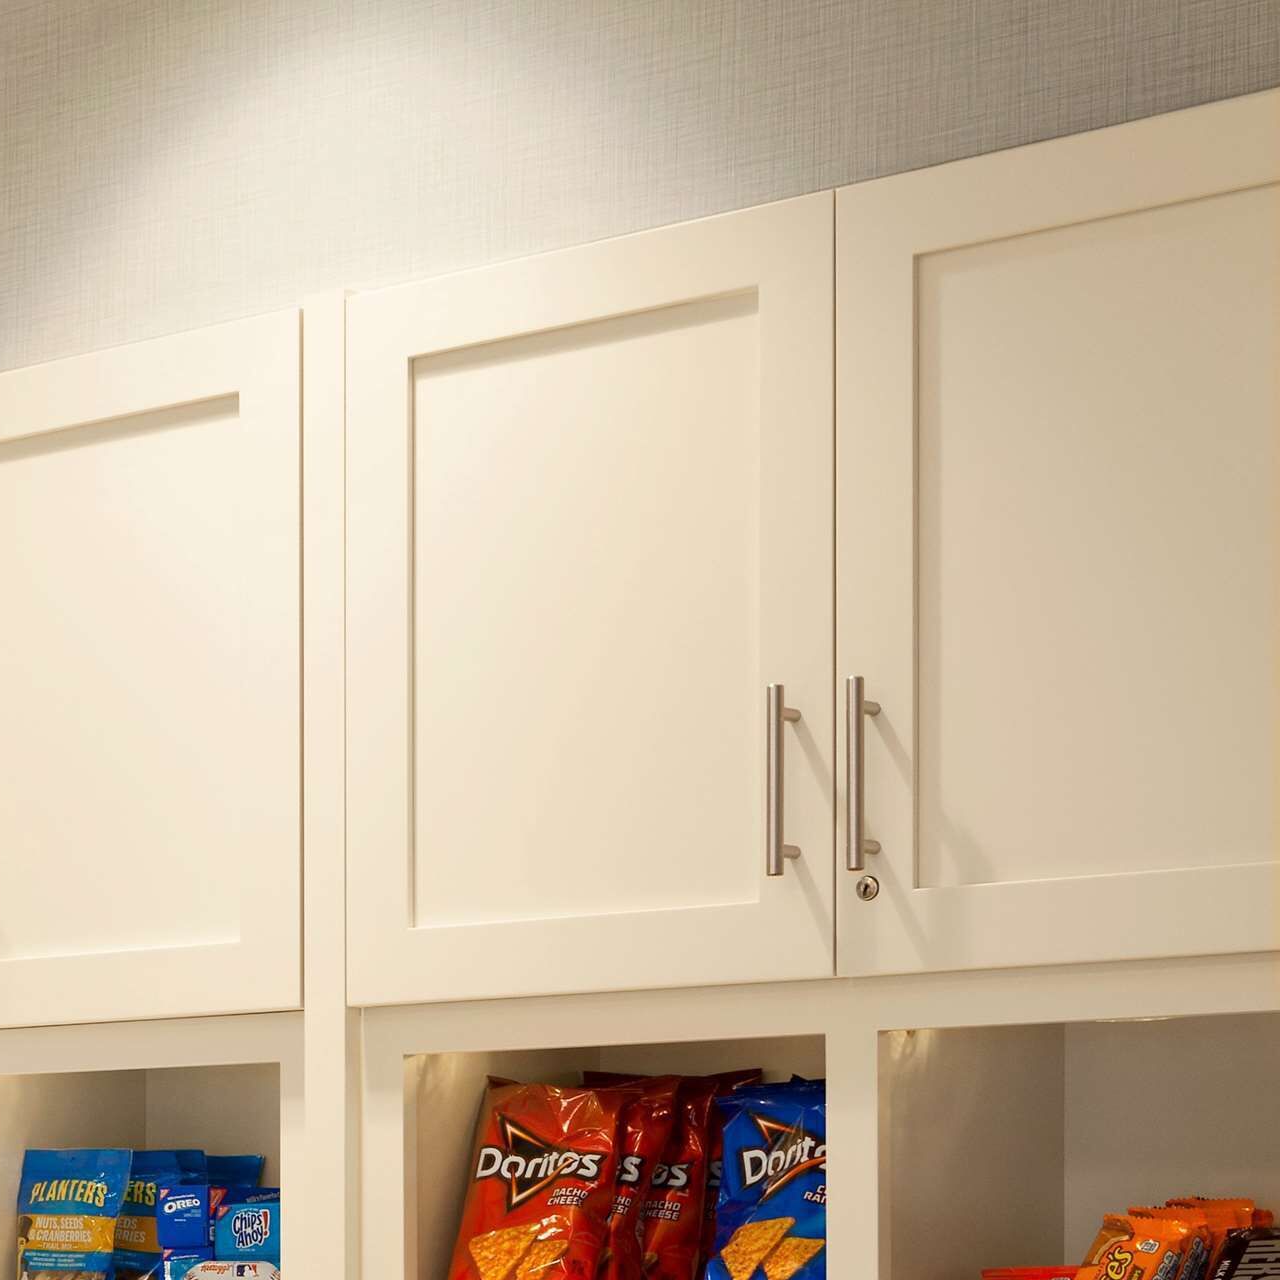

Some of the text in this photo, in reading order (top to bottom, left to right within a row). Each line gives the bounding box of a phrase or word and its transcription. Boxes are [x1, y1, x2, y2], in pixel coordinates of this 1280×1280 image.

[476, 1147, 602, 1180] Doritos
[743, 1136, 827, 1185] Dorito
[29, 1179, 107, 1207] PLANTERS
[552, 1187, 589, 1199] NACHO
[164, 1198, 200, 1213] OREO
[547, 1197, 583, 1206] CHEESE
[35, 1216, 84, 1230] NUTS, SEEDS
[232, 1211, 262, 1236] Chips
[36, 1229, 93, 1242] CRANBERRIES
[200, 1263, 232, 1275] Kellogg's
[1217, 1259, 1232, 1278] MILK
